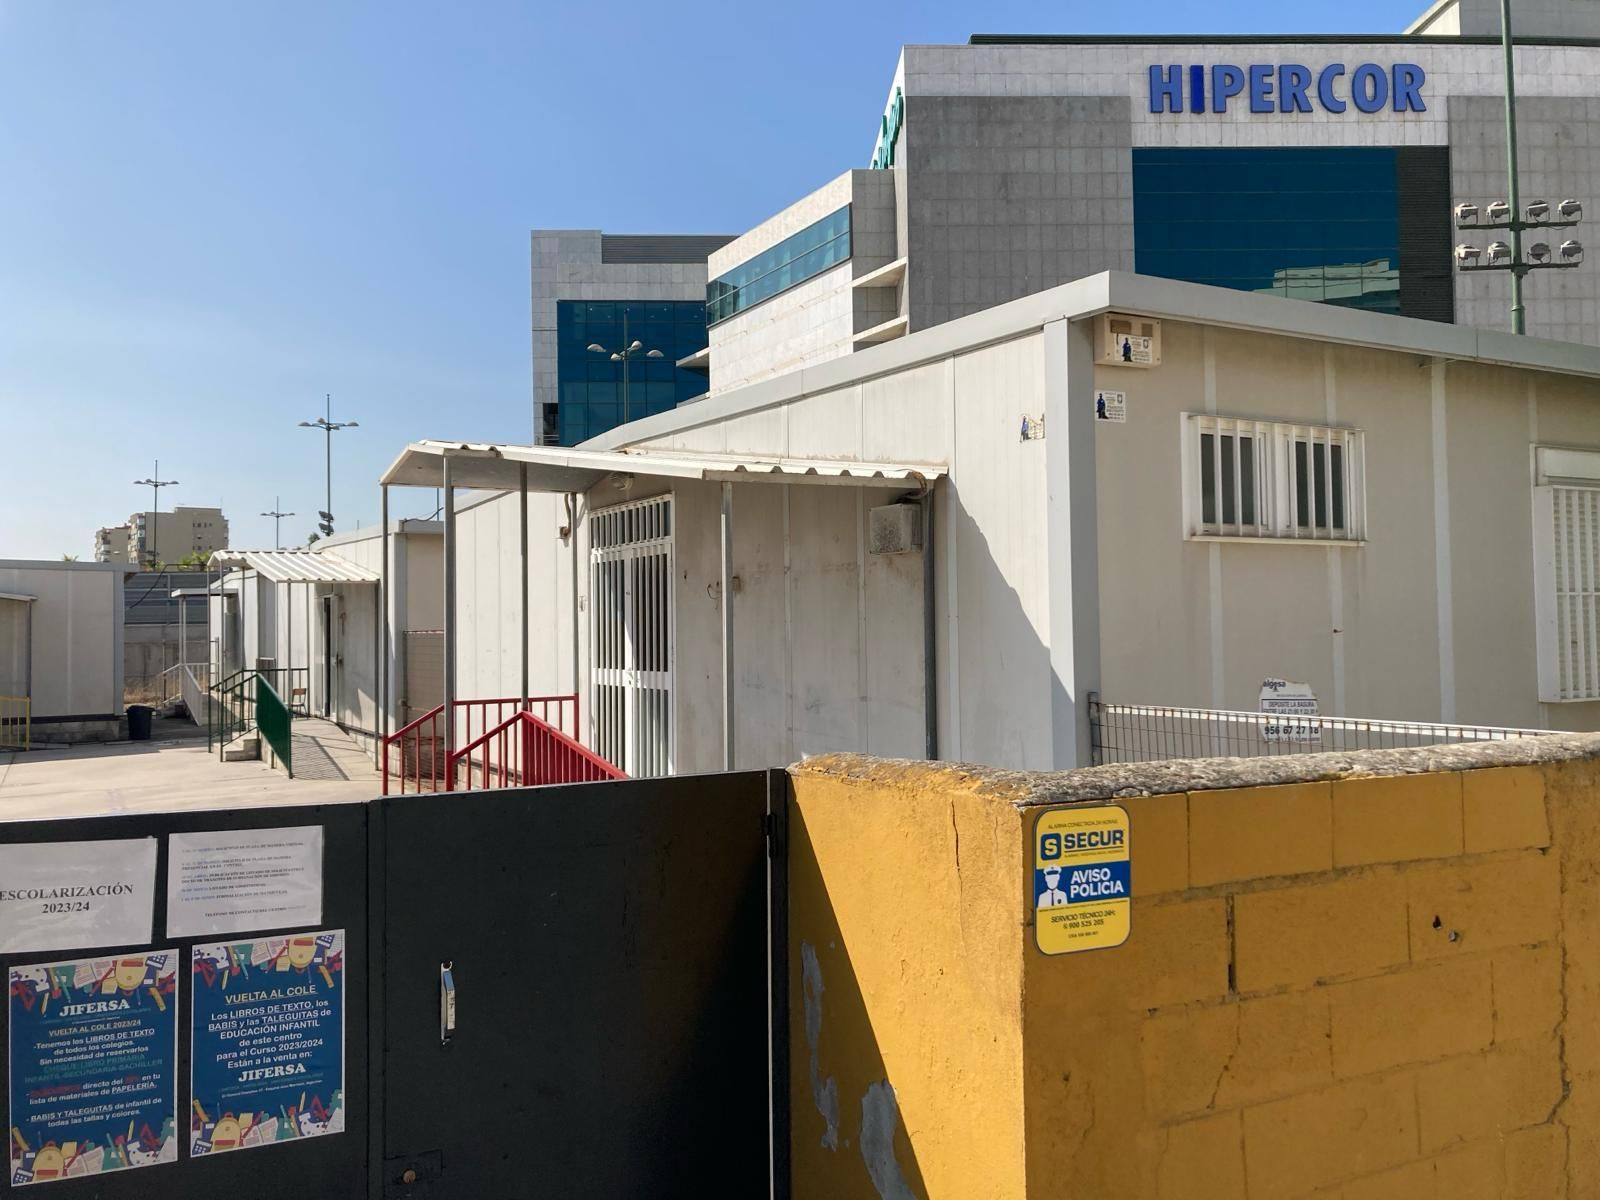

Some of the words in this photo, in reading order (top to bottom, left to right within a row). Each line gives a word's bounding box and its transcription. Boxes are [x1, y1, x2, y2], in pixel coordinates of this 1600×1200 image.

[1149, 63, 1427, 114] HIPERCOR
[1265, 726, 1279, 734] 956
[1283, 726, 1292, 734] 67
[1296, 726, 1305, 734] 27
[1064, 830, 1124, 849] SECUR
[1071, 868, 1111, 884] AVISO
[0, 882, 133, 901] ESCOLARIZACIÓN
[41, 901, 90, 913] 2023/24
[1051, 913, 1078, 923] SERVICIO
[225, 991, 267, 1004] VUELTA
[269, 989, 284, 999] AL
[287, 985, 316, 996] COLE
[59, 999, 130, 1017] JIFERSA
[211, 1013, 228, 1021] Los
[230, 1008, 265, 1019] LIBROS
[267, 1005, 280, 1014] DE
[208, 1020, 237, 1032] BABIS
[239, 1021, 244, 1029] y
[246, 1017, 259, 1026] las
[262, 1011, 319, 1024] TALEGUITAS
[321, 1009, 331, 1017] de
[50, 1027, 77, 1037] VUELTA
[79, 1025, 90, 1033] AL
[91, 1022, 111, 1031] COLE
[85, 1033, 115, 1043] LIBROS
[117, 1031, 128, 1040] DE
[130, 1028, 155, 1038] TEXTO
[220, 1024, 277, 1040] EDUCACIÓN
[279, 1020, 320, 1031] INFANTIL
[239, 1038, 250, 1047] de
[252, 1037, 270, 1045] este
[272, 1032, 302, 1042] centro
[40, 1057, 52, 1065] Sin
[53, 1052, 93, 1063] necesidad
[95, 1050, 105, 1058] de
[106, 1046, 148, 1057] reservarlos
[65, 1045, 87, 1053] todos
[217, 1051, 237, 1062] para
[239, 1049, 248, 1057] el
[250, 1044, 276, 1055] Curso
[278, 1038, 323, 1051] 2023/2024
[227, 1058, 253, 1069] Están
[263, 1056, 271, 1064] la
[273, 1051, 298, 1062] venta
[239, 1064, 306, 1082] JIFERSA
[83, 1081, 113, 1090] directo
[29, 1096, 46, 1105] lista
[59, 1090, 99, 1100] materiales
[30, 1112, 55, 1121] BABIS
[64, 1104, 113, 1116] TALEGUITAS
[126, 1098, 151, 1107] infantil
[48, 1119, 69, 1127] todas
